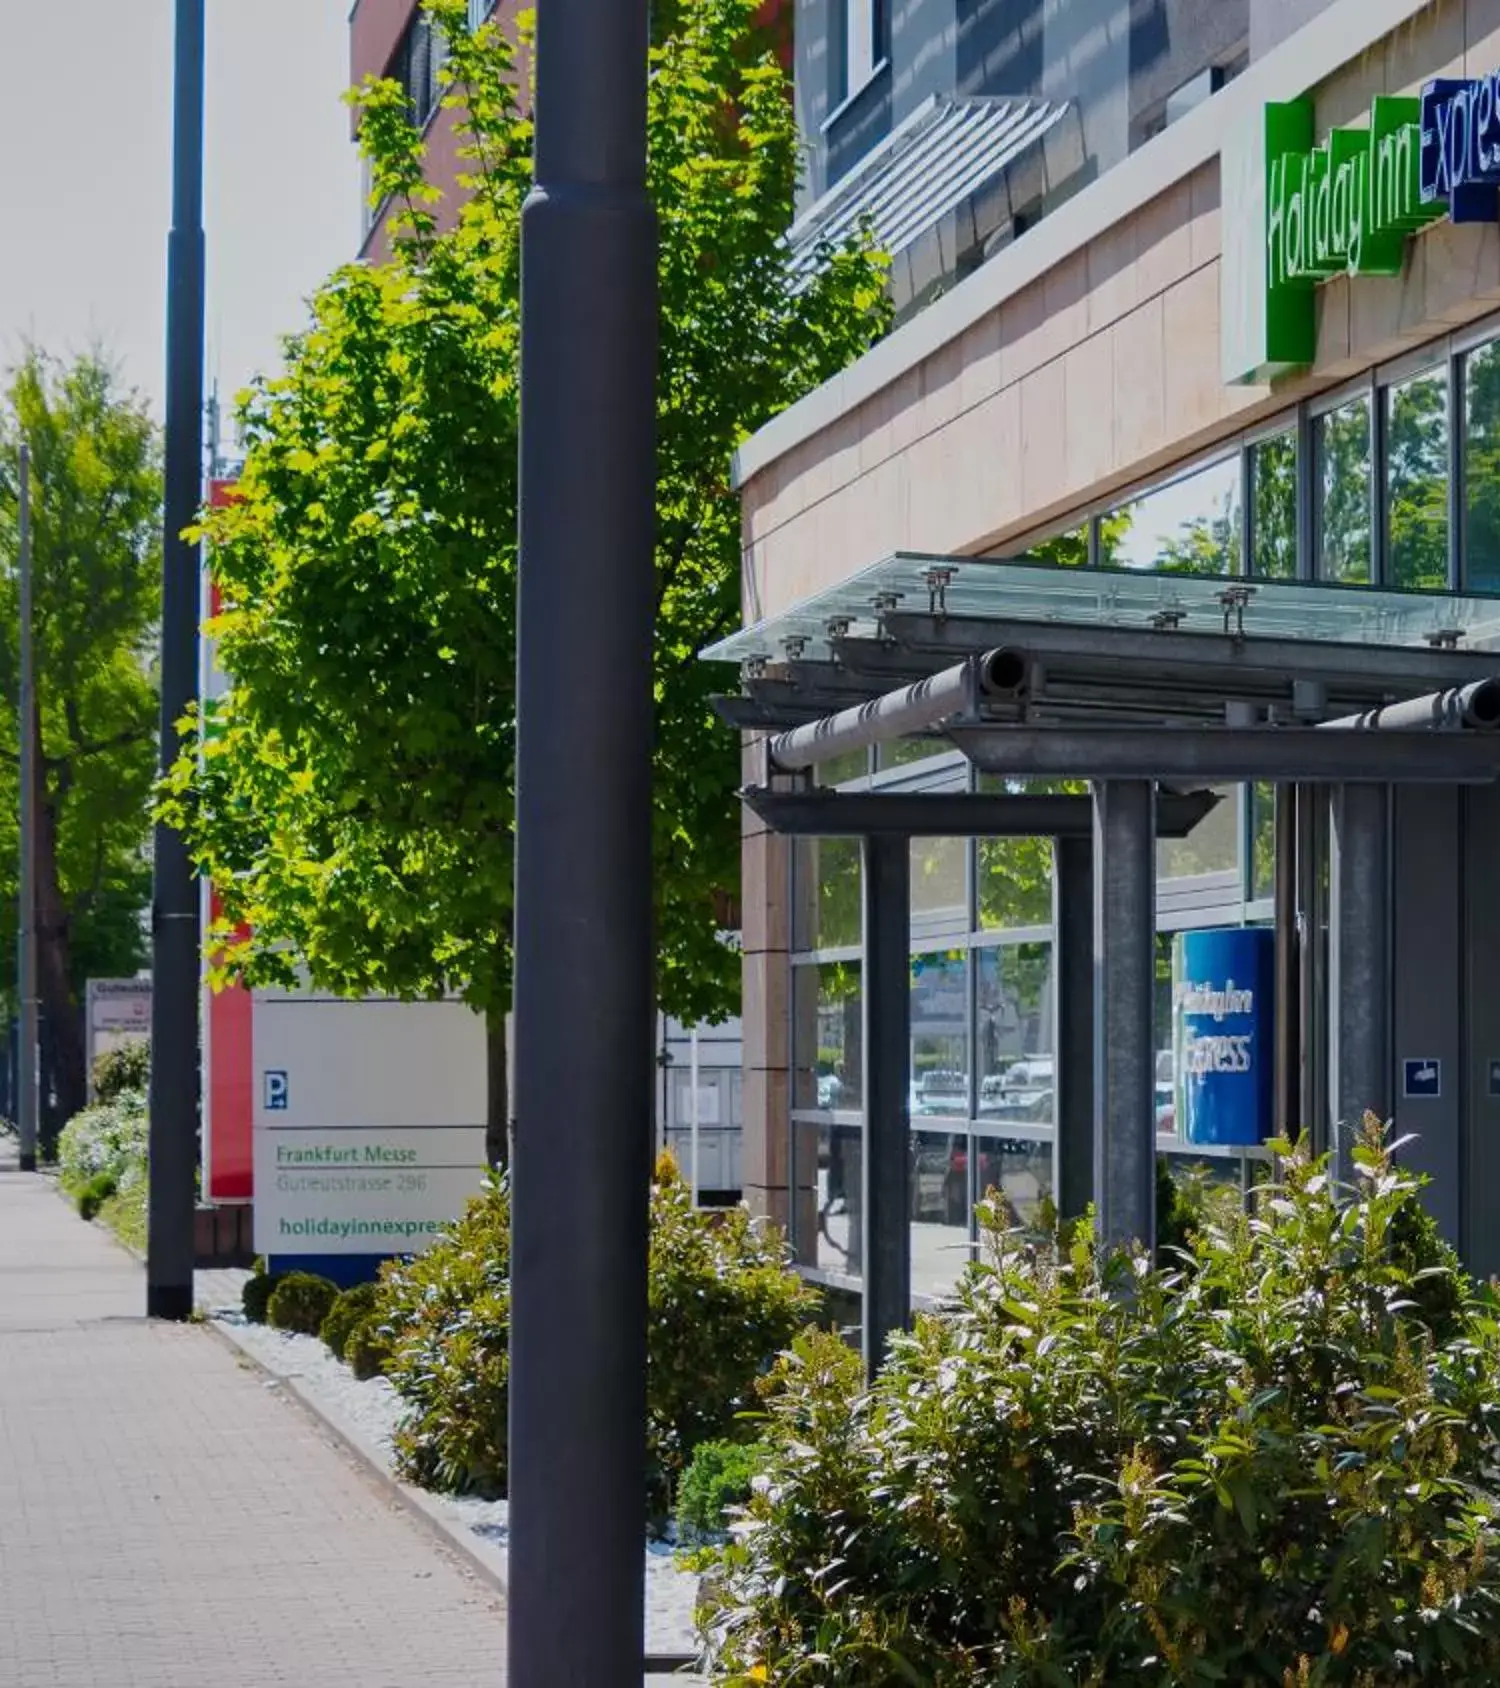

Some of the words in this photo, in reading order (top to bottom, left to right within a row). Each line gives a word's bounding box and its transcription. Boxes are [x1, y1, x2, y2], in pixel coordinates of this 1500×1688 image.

[1267, 127, 1367, 288] Holiday
[1369, 95, 1413, 235] Inn
[276, 1145, 358, 1163] Frankfurt
[364, 1145, 417, 1163] Messe
[396, 1173, 427, 1192] 296
